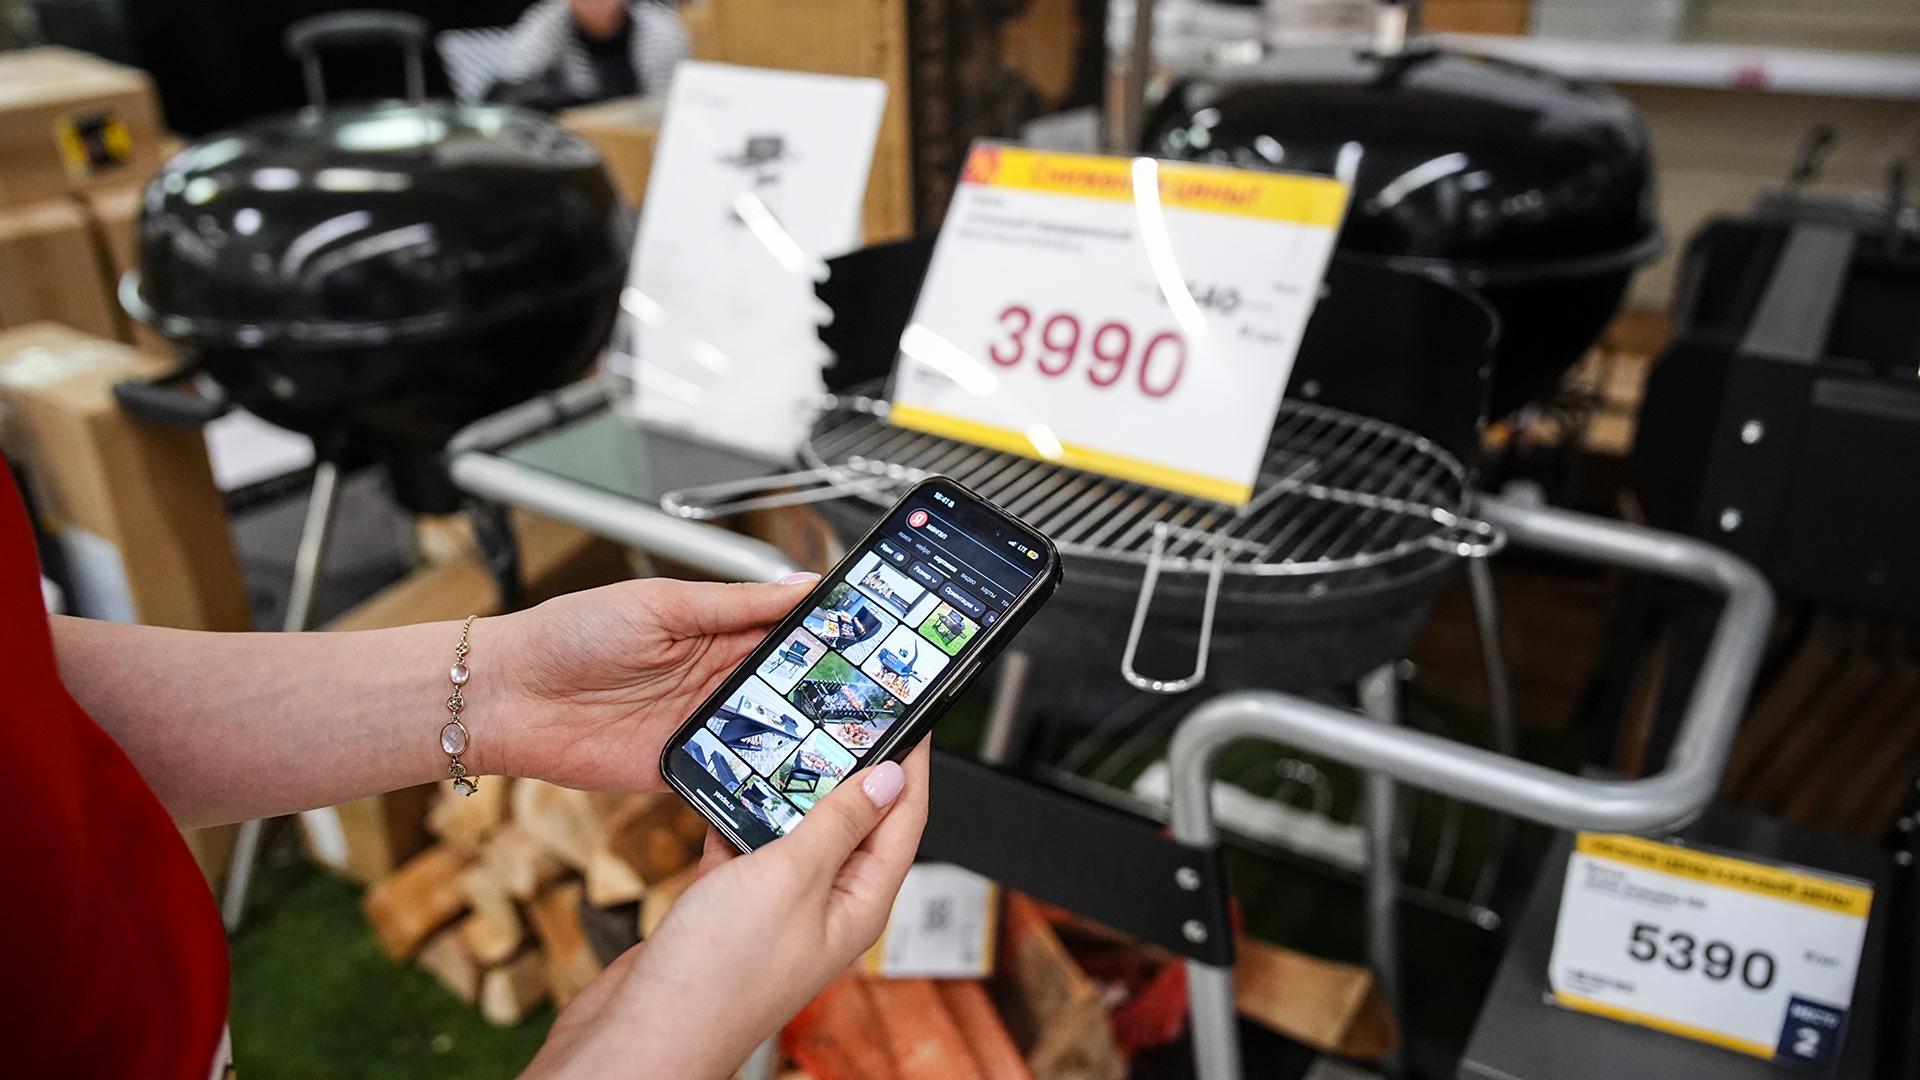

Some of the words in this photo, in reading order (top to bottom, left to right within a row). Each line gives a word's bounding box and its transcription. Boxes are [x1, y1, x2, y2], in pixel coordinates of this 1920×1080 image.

[988, 305, 1188, 400] 3990
[926, 523, 948, 540] мангал
[1017, 544, 1029, 554] LTE
[913, 565, 931, 580] Размер
[945, 586, 974, 609] Ориентация
[960, 573, 976, 585] видео
[980, 586, 997, 599] карты
[713, 790, 736, 811] yandex.ru
[1627, 919, 1776, 991] 5390
[1793, 1027, 1821, 1059] 2
